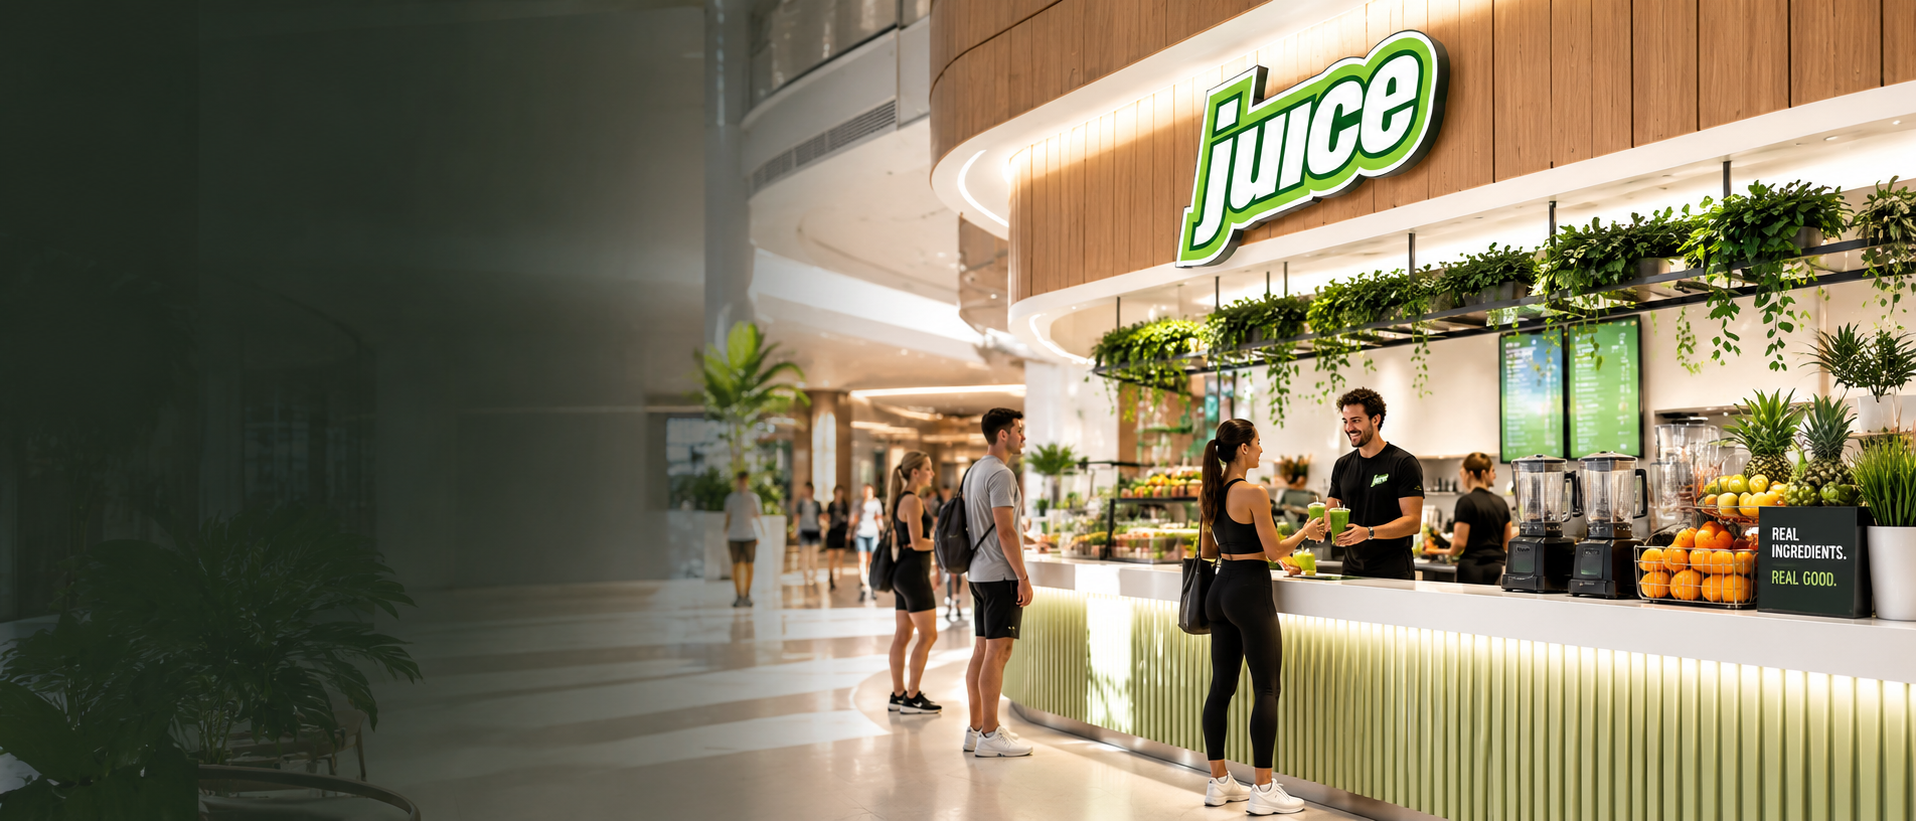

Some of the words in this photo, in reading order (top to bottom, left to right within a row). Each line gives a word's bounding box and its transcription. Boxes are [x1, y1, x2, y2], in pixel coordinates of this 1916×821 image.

[1191, 52, 1421, 248] juice
[1772, 527, 1799, 541] REAL
[1771, 544, 1847, 560] INGREDIENTS.
[1772, 570, 1799, 585] REAL
[1803, 571, 1837, 587] GOOD.
